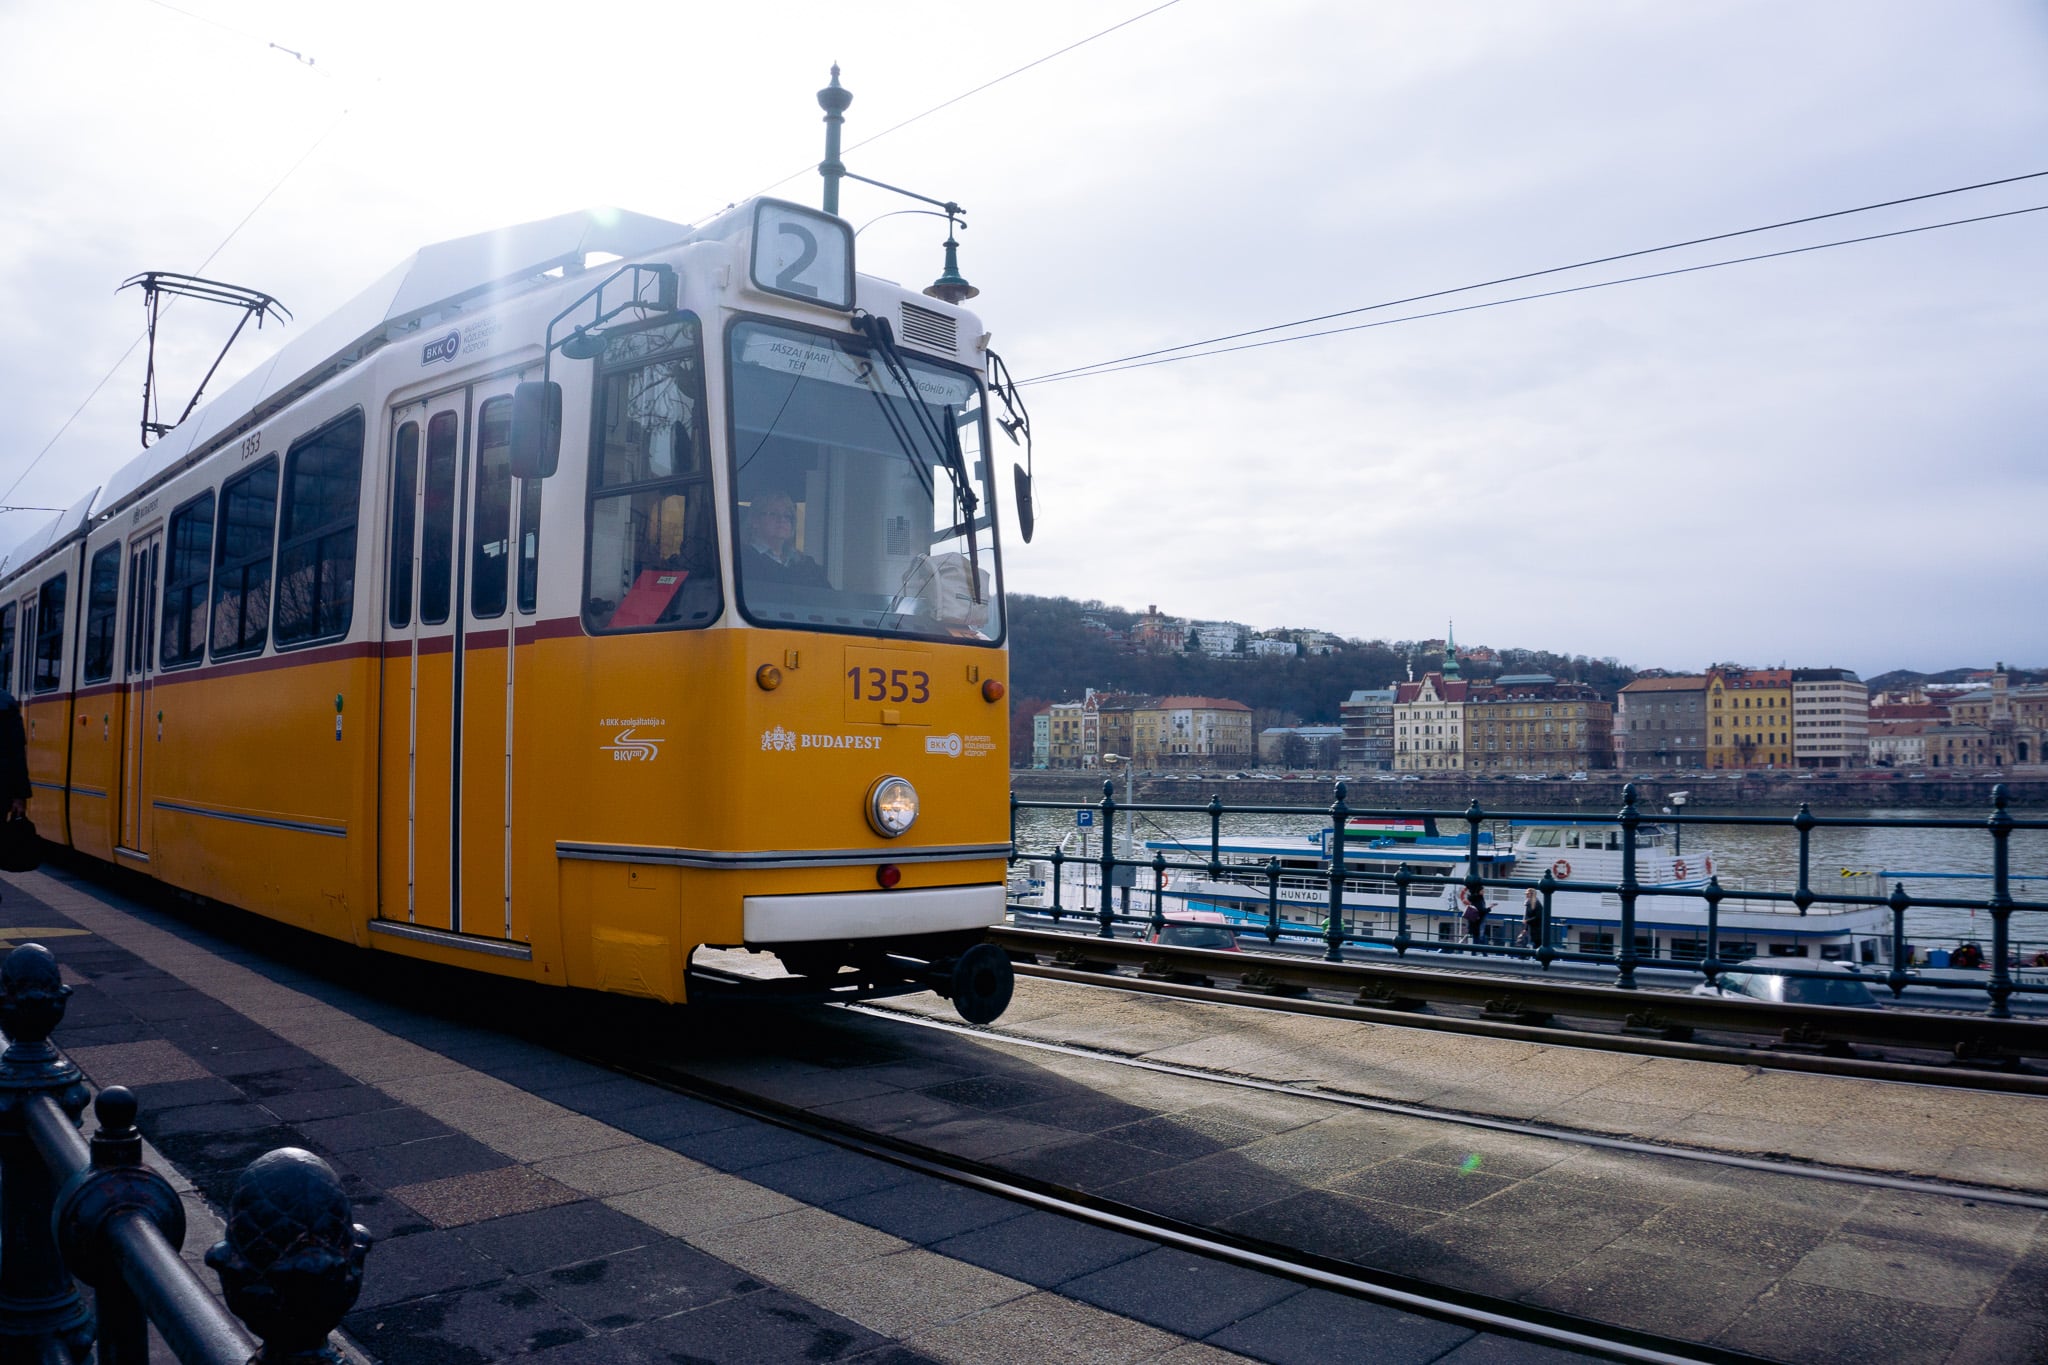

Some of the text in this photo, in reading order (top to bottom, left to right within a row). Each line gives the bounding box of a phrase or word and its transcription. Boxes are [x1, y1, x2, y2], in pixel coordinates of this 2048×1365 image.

[775, 222, 818, 297] 2
[426, 343, 443, 359] BKK
[804, 350, 830, 364] MARI
[788, 358, 806, 370] TÉR
[854, 361, 874, 385] 2
[241, 431, 261, 461] 1353
[847, 666, 930, 704] 1353
[801, 734, 882, 750] BUDAPEST
[1080, 812, 1090, 823] P
[1281, 890, 1322, 901] HUNYADI
